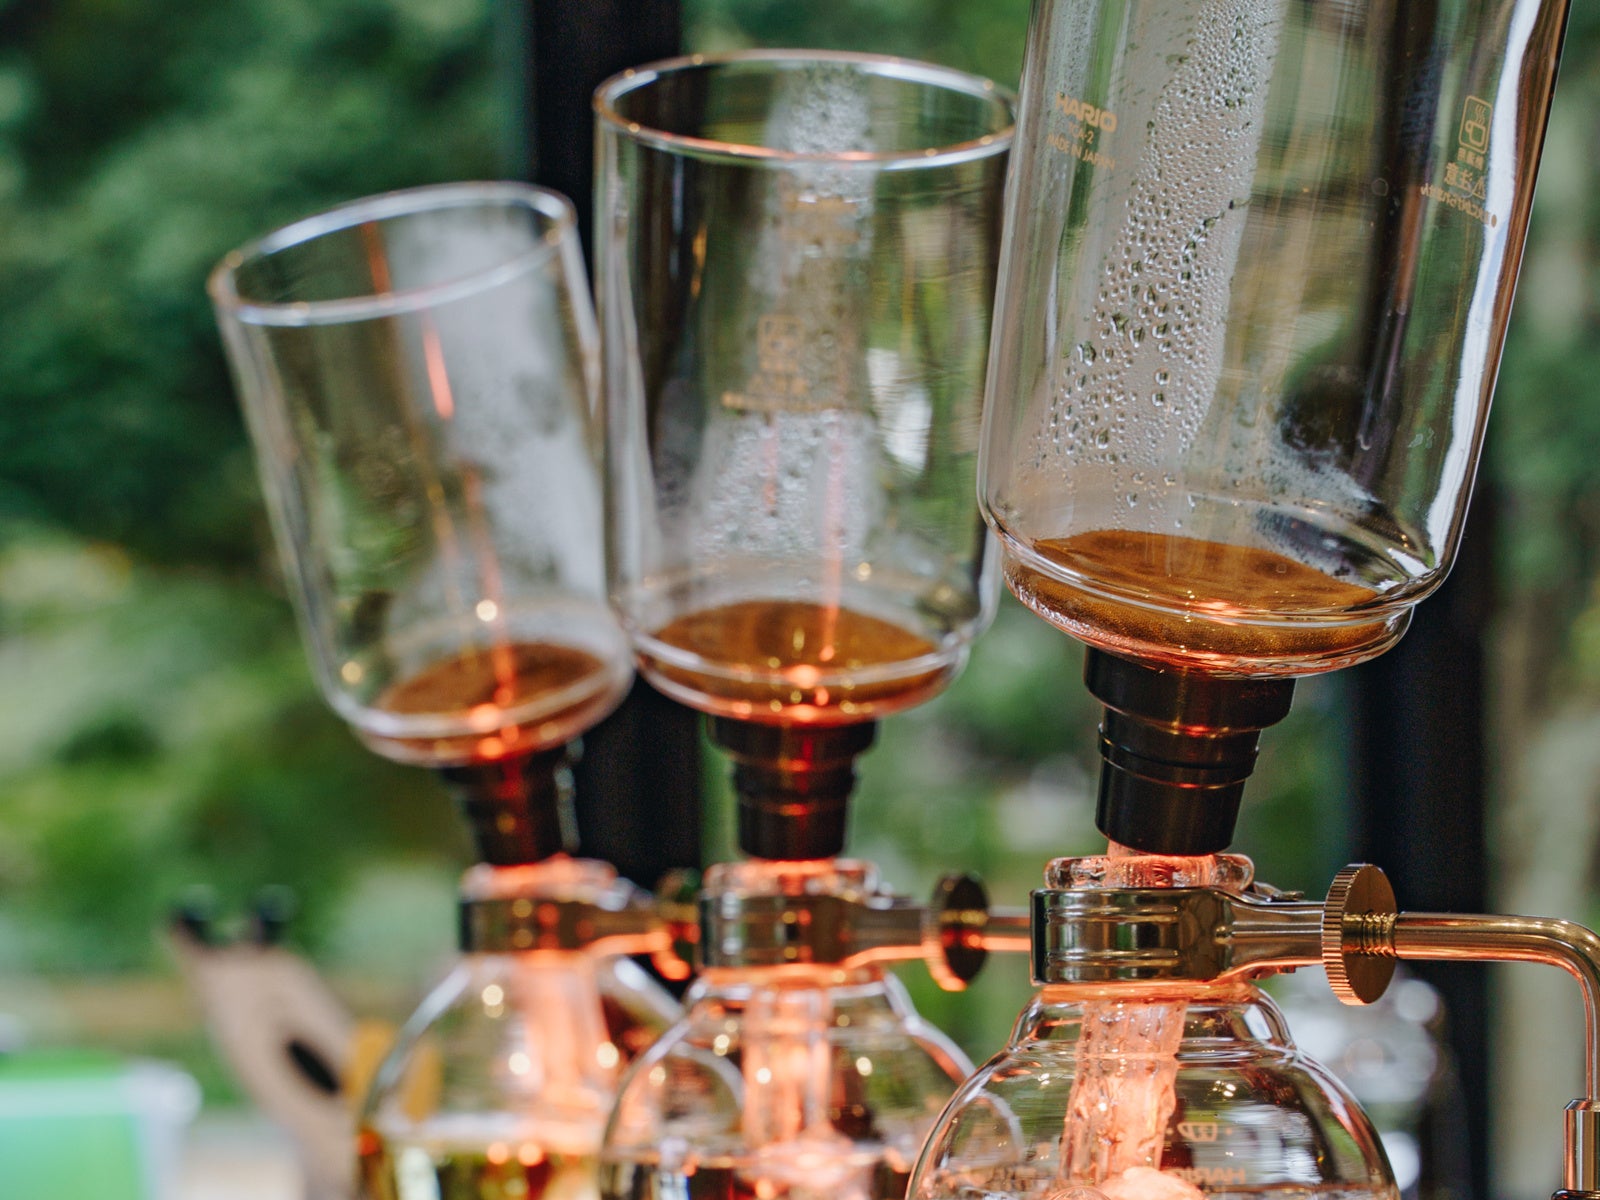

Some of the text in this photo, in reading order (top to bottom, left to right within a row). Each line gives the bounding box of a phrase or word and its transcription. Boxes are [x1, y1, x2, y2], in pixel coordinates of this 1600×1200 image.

[1055, 91, 1118, 133] HARIO
[1046, 132, 1117, 172] MADE IN JAPAN
